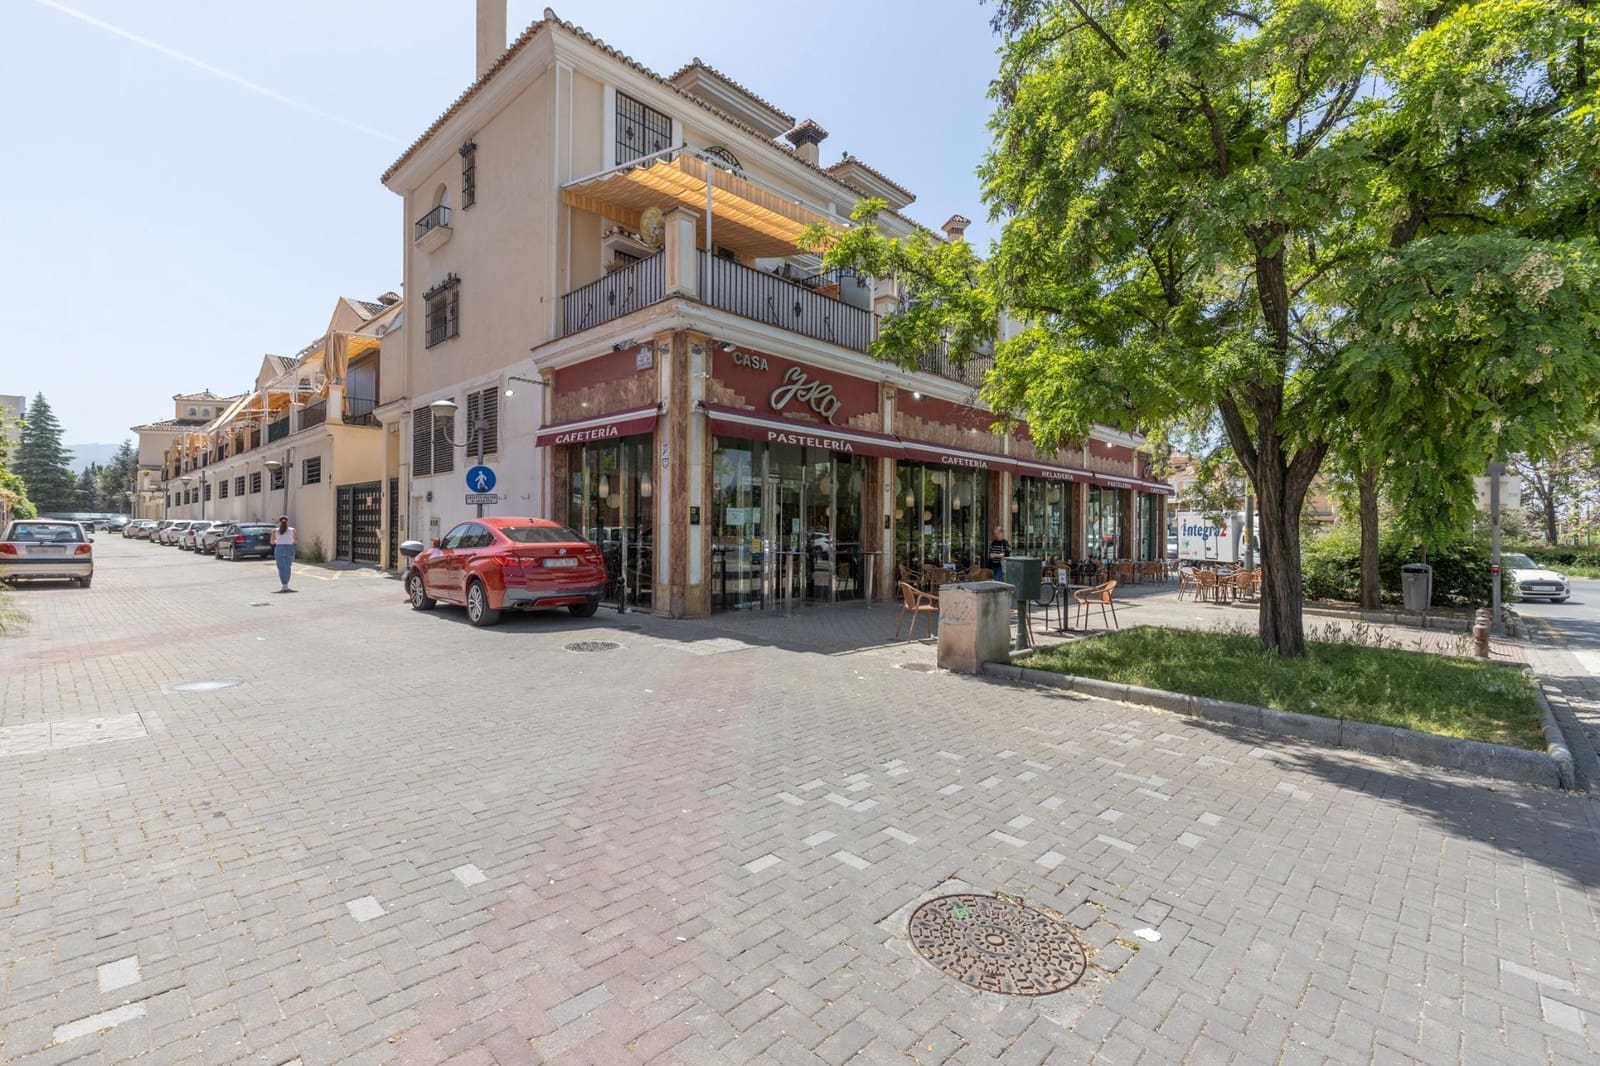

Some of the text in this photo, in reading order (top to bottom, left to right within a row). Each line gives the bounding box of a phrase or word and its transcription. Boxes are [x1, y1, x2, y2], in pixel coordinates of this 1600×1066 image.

[733, 352, 769, 371] CASA
[555, 425, 619, 444] CAFETERÍA
[768, 431, 853, 452] PASTELERÍA
